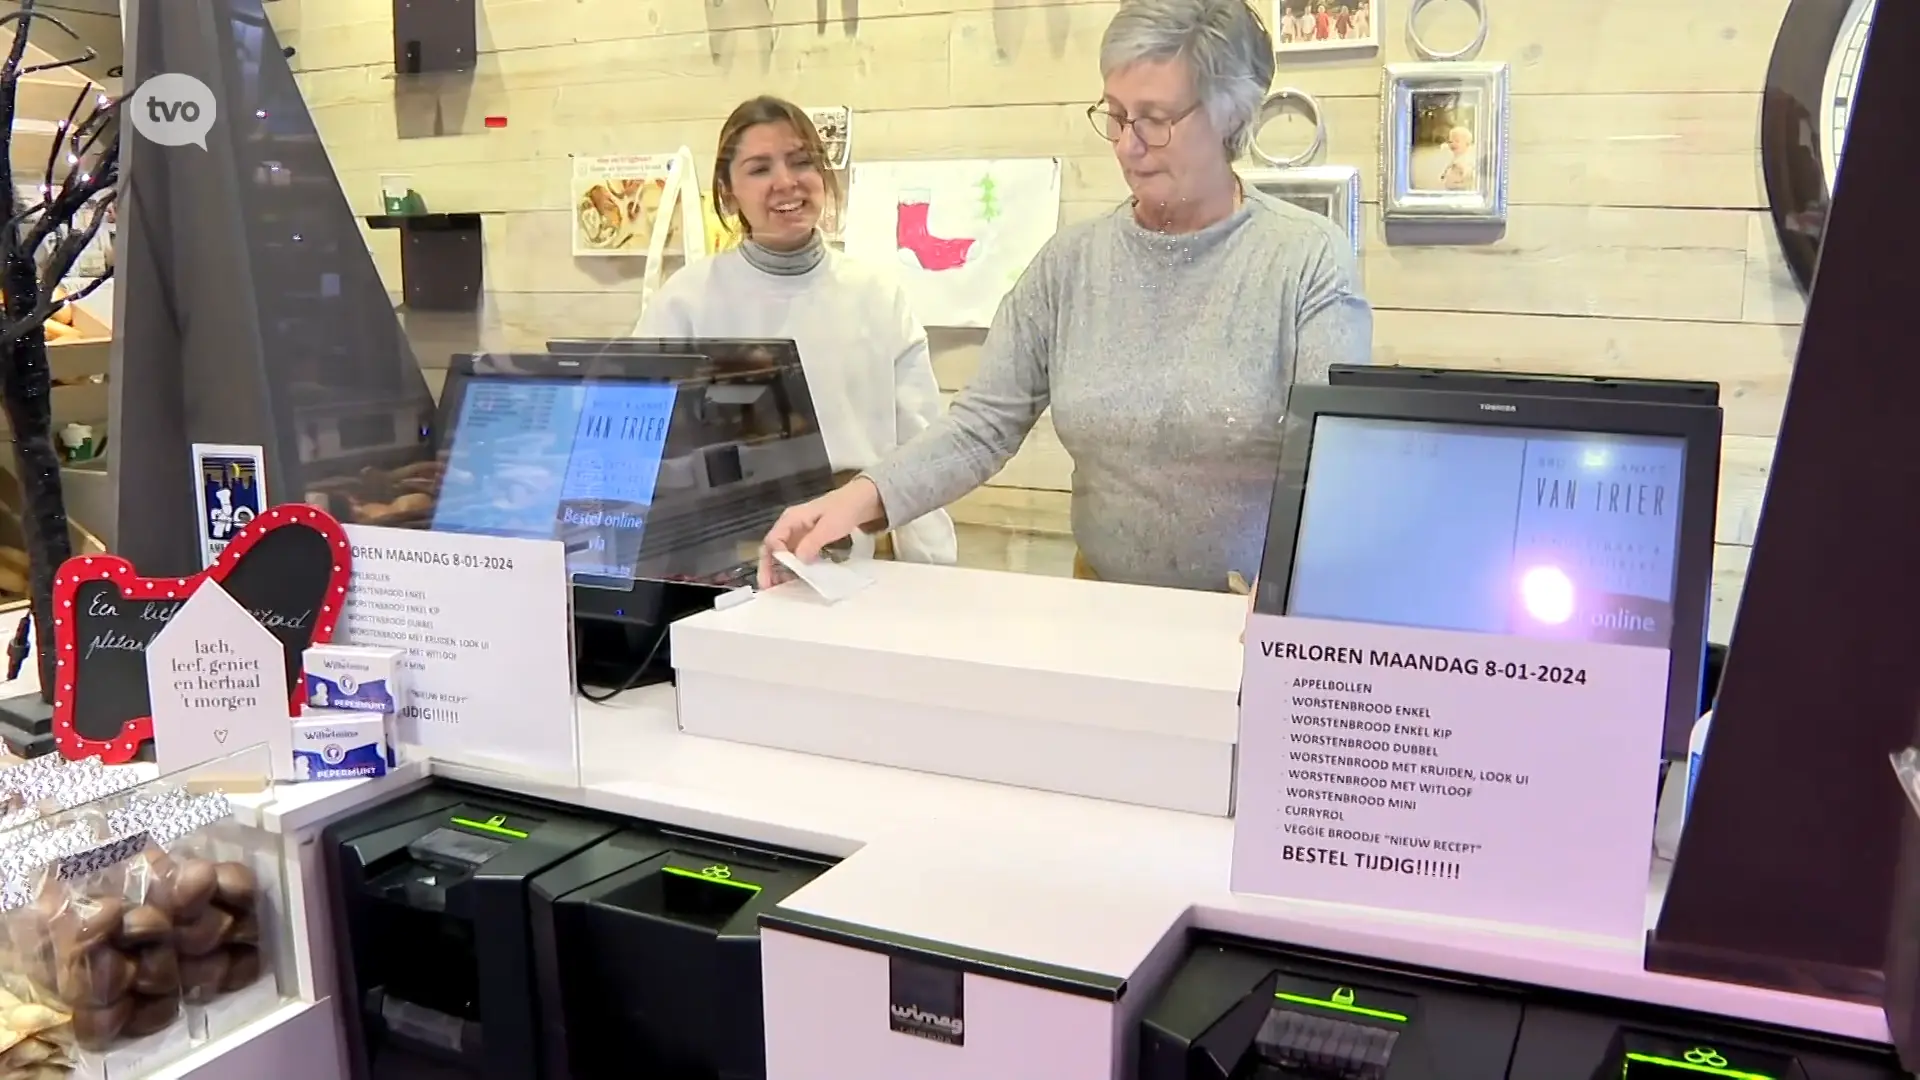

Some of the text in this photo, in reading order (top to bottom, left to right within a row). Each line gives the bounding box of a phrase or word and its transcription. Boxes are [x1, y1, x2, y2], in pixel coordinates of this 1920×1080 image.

[586, 415, 666, 442] VAN TRIER
[1536, 477, 1665, 516] VAN TRIER
[563, 507, 643, 529] Bestel online
[386, 548, 450, 566] MAANDAG
[452, 553, 514, 571] 8-01-2024
[88, 591, 120, 616] Een
[1591, 606, 1657, 633] online
[194, 639, 234, 656] lach,
[171, 658, 260, 675] leef, geniet
[1260, 641, 1587, 685] VERLOREN MAANDAG 8-01-2024
[173, 674, 261, 690] en herhaal
[1292, 677, 1373, 694] APPELBOLLEN
[194, 697, 257, 712] morgen
[1292, 696, 1432, 719] WORSTENBROOD ENKEL
[1291, 714, 1453, 740] WORSTENBROOD ENKEL KIP
[1290, 733, 1439, 757] WORSTENBROOD DUBBEL
[317, 767, 376, 778] PEPERMUNT
[1289, 751, 1529, 786] WORSTENBROOD MET KRUIDEN, LOOK UI
[1288, 769, 1473, 798] WORSTENBROOD MET WITLOOF
[1286, 787, 1416, 810] WORSTENBROOD MINI
[1284, 805, 1344, 821] CURRYROL
[1284, 823, 1482, 855] VEGGIE BROODJE "NIEUW RECEPT"
[1282, 845, 1461, 879] BESTEL TIJDIG!!!!!!
